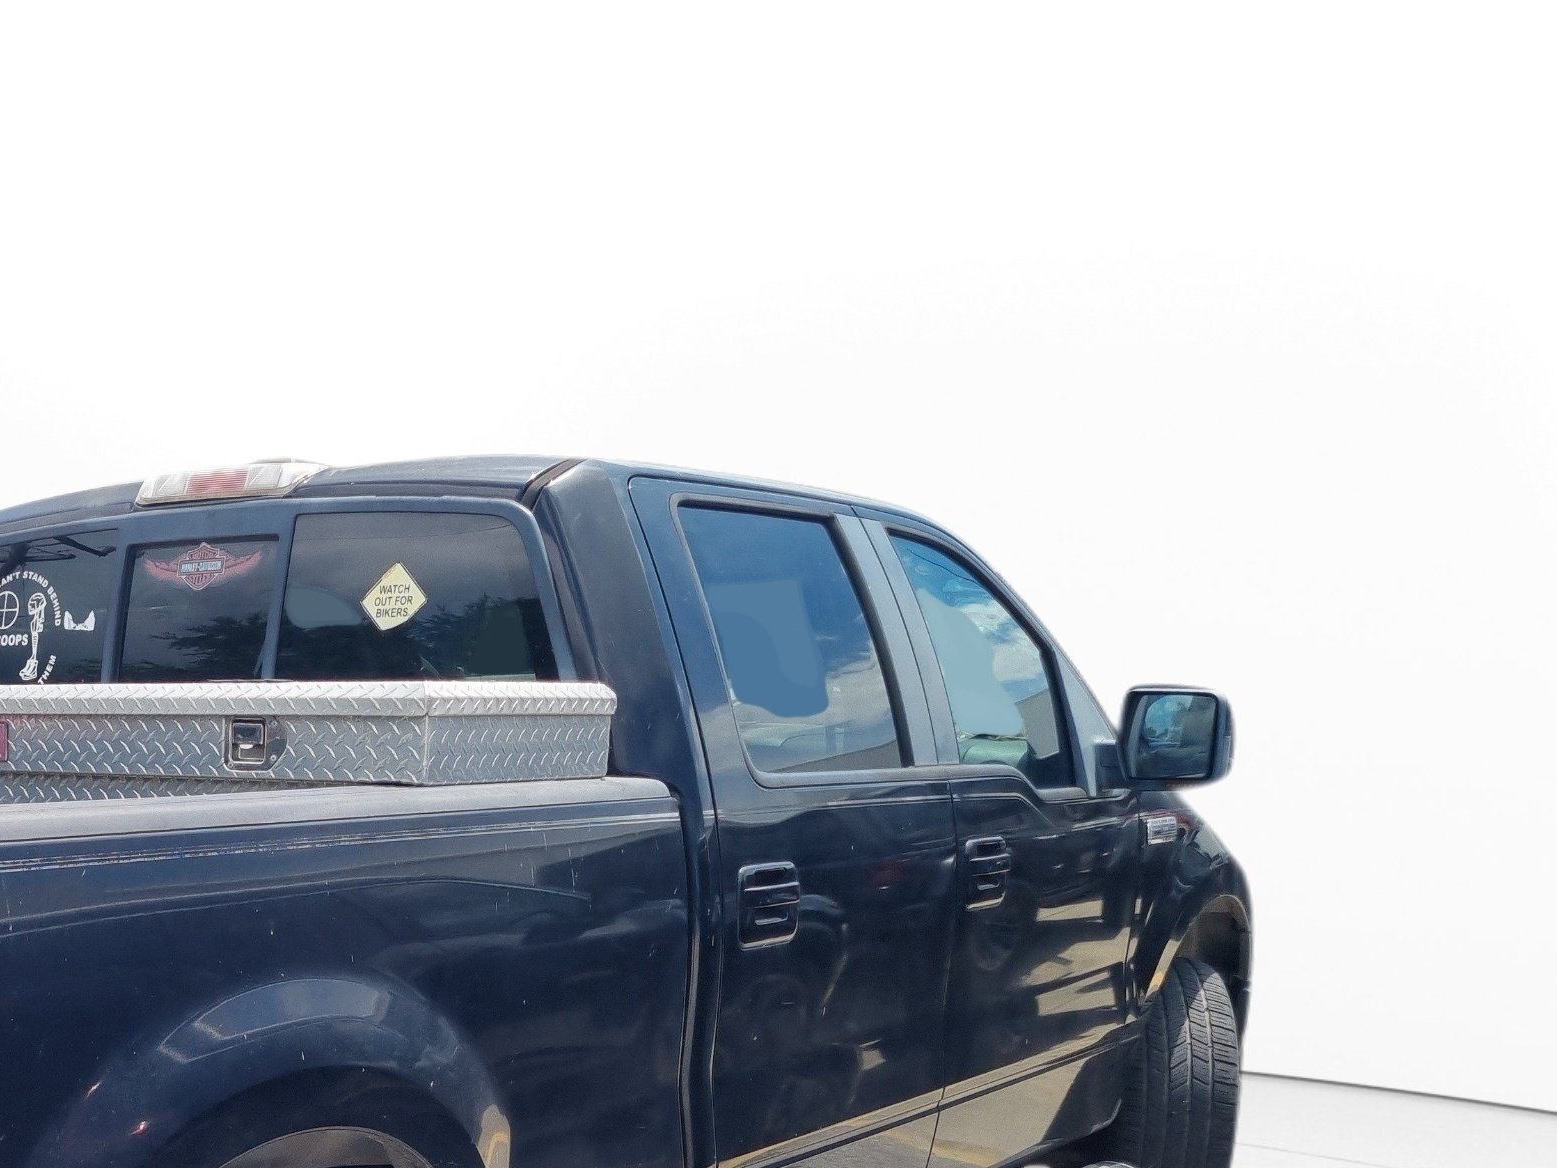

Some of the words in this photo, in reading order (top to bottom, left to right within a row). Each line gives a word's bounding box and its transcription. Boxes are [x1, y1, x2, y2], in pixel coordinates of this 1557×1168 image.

[379, 584, 411, 595] WATCH
[22, 570, 49, 588] STAND
[46, 585, 62, 627] BEHIND
[374, 596, 393, 607] OUT
[394, 595, 414, 606] FOR
[375, 607, 409, 618] BIKERS
[37, 654, 57, 685] THEM
